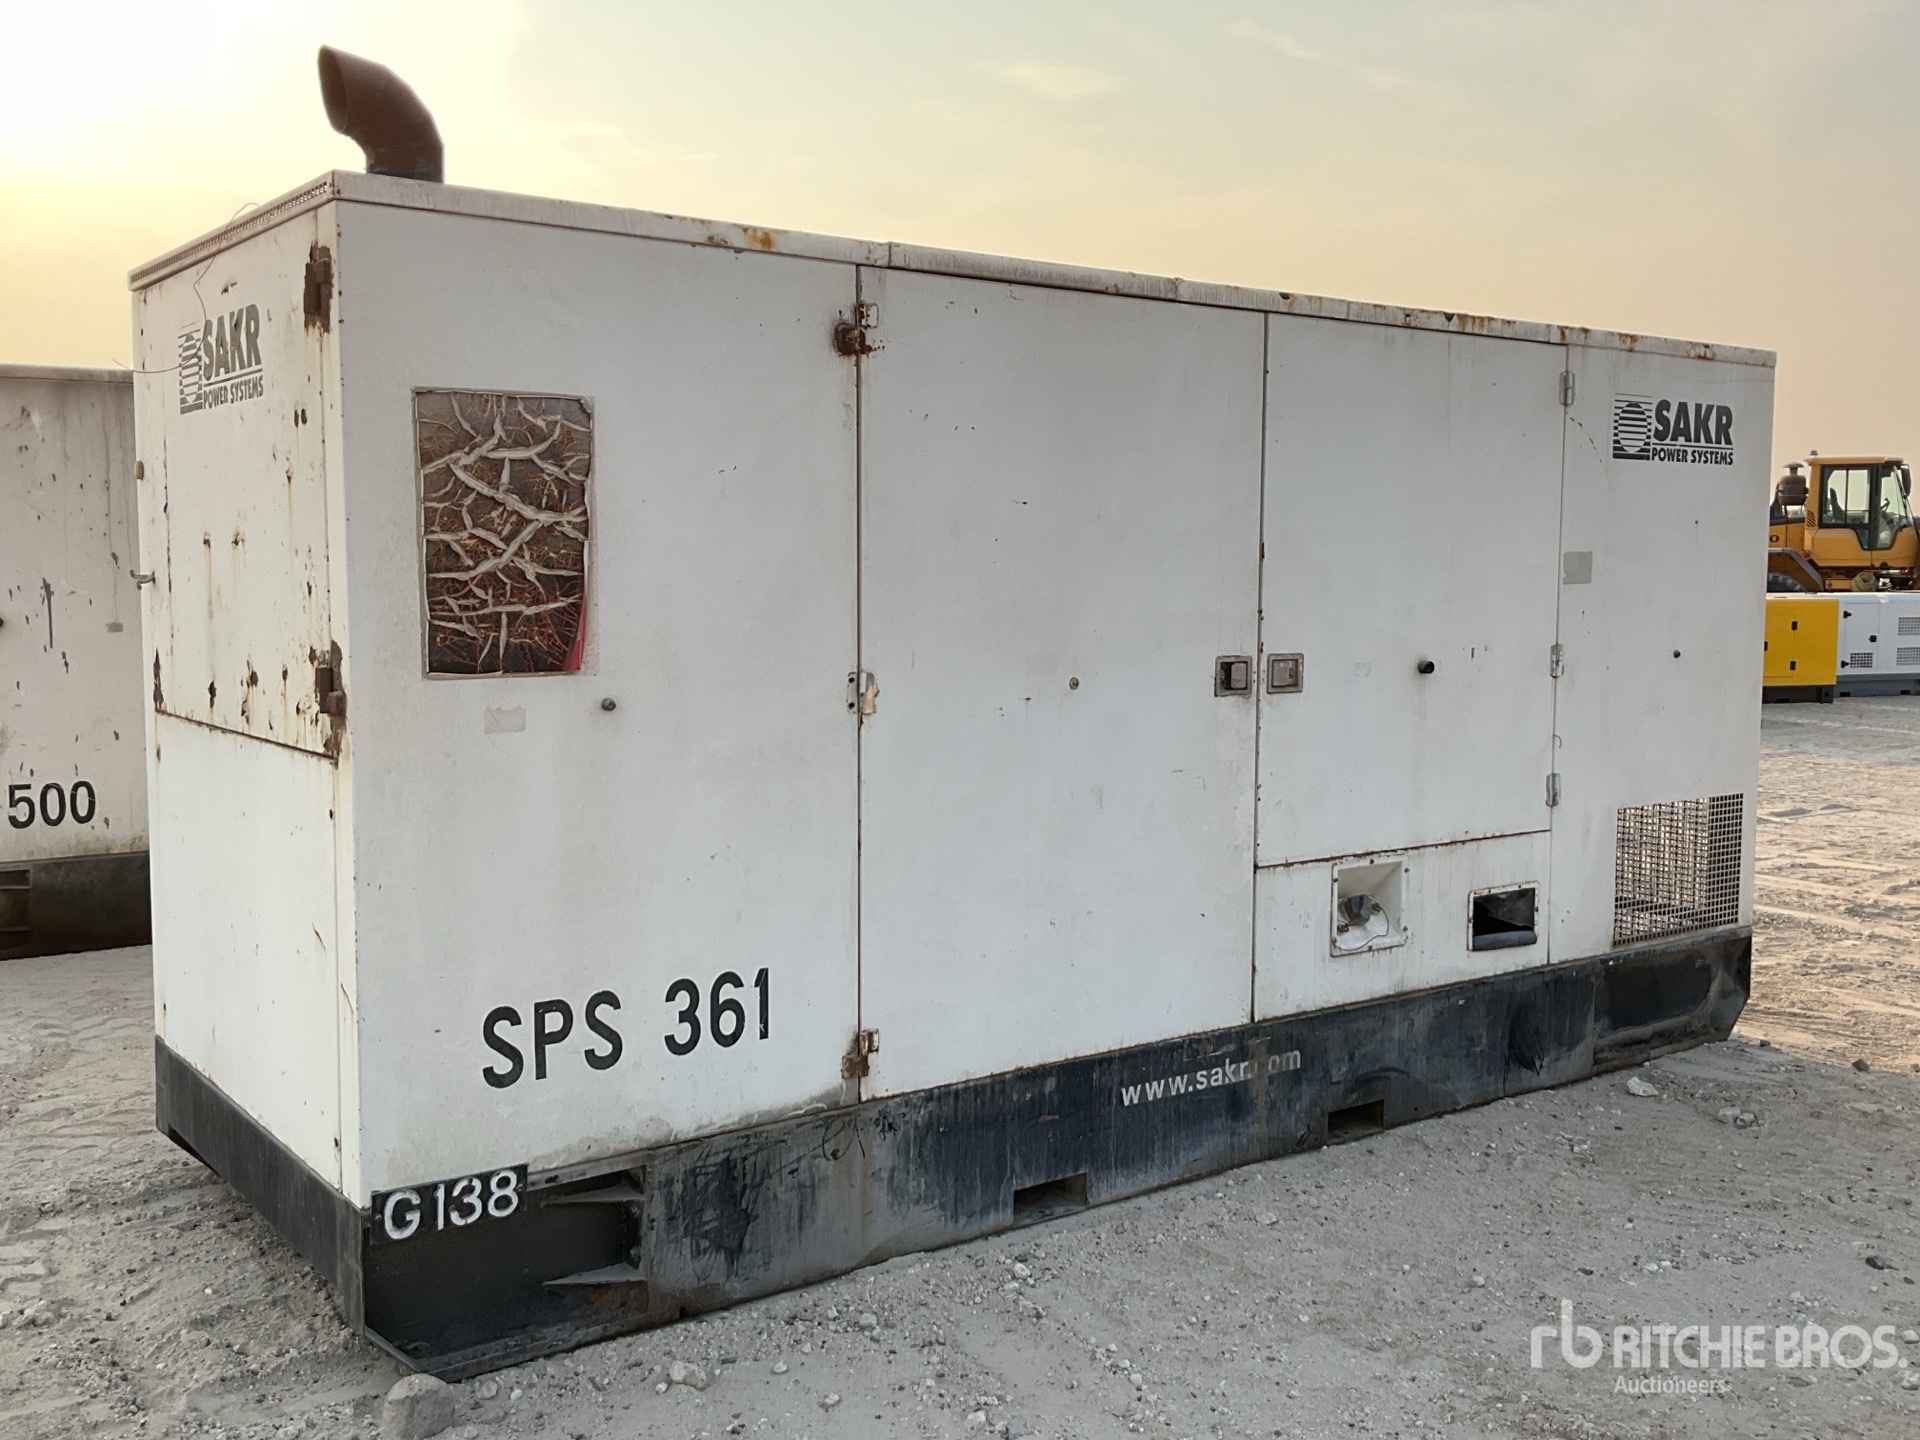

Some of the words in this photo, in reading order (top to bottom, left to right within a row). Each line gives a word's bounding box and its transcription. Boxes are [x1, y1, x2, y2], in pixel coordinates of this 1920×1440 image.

[203, 304, 262, 381] SAKR
[203, 386, 229, 410] POWER
[230, 375, 264, 404] SYSTEMS
[1653, 399, 1733, 446] SAKR
[1651, 447, 1688, 462] POWER
[1690, 449, 1734, 465] SYSTEMS
[8, 780, 96, 829] 500
[482, 990, 623, 1089] SPS
[664, 967, 770, 1056] 361
[384, 1189, 421, 1240] G
[433, 1169, 519, 1231] 138
